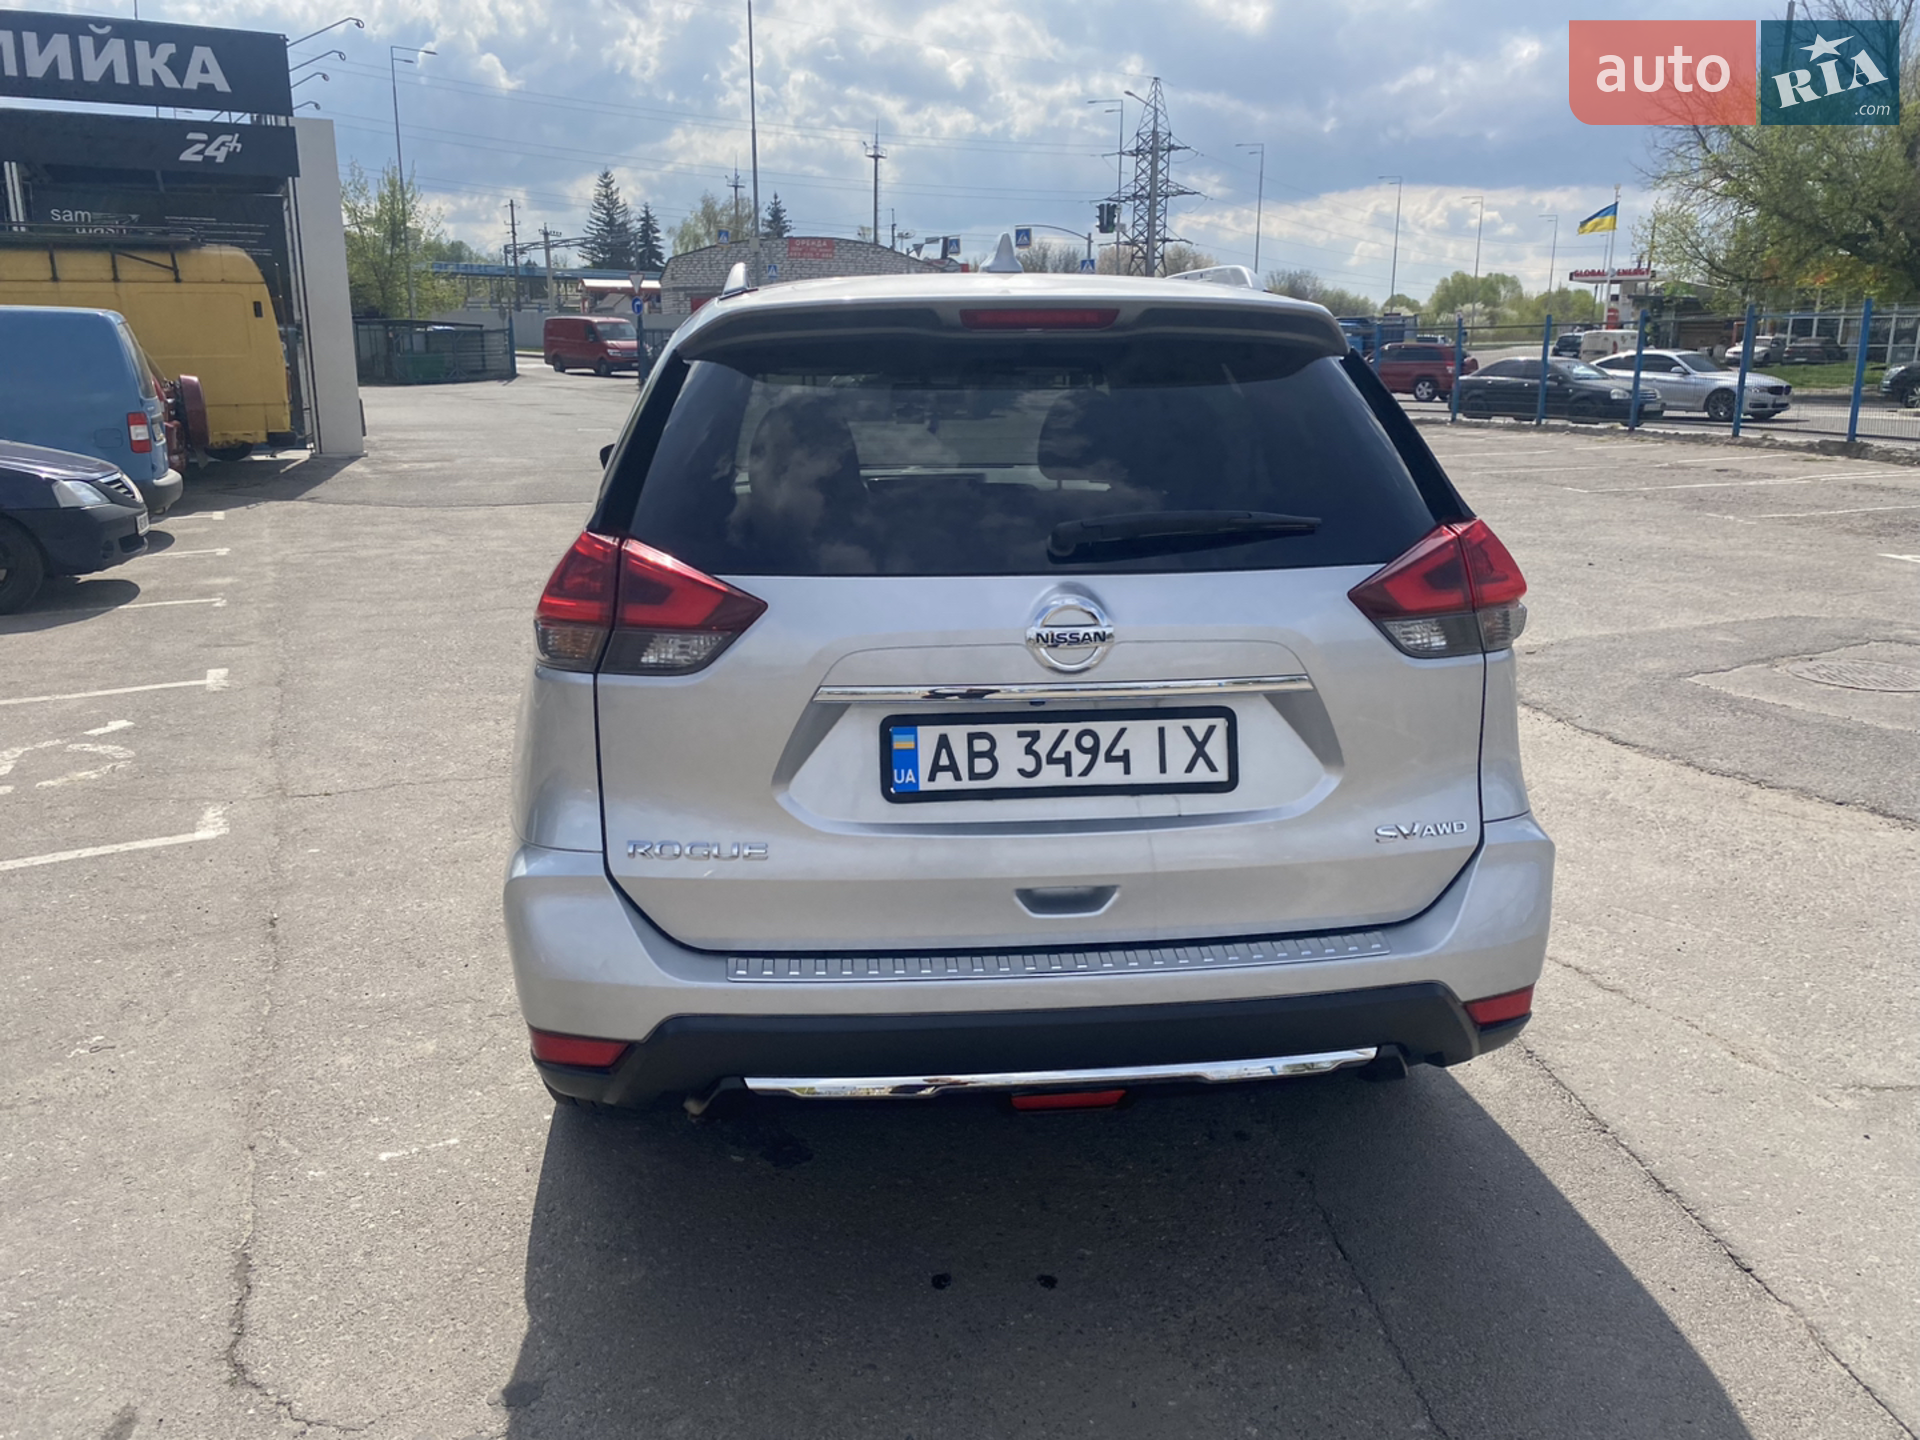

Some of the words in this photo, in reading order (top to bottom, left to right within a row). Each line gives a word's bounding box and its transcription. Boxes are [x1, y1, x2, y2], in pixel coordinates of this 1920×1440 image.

[50, 208, 92, 223] sam
[1573, 268, 1606, 278] GLOBAL
[1616, 267, 1651, 277] ENERGY
[1036, 630, 1107, 645] NISSAN
[927, 731, 999, 782] AB
[1016, 727, 1131, 778] 3494
[1157, 724, 1219, 775] IX
[893, 768, 916, 784] UA
[1375, 822, 1420, 843] SV
[1420, 820, 1468, 838] AWD
[627, 840, 769, 861] ROGUE
